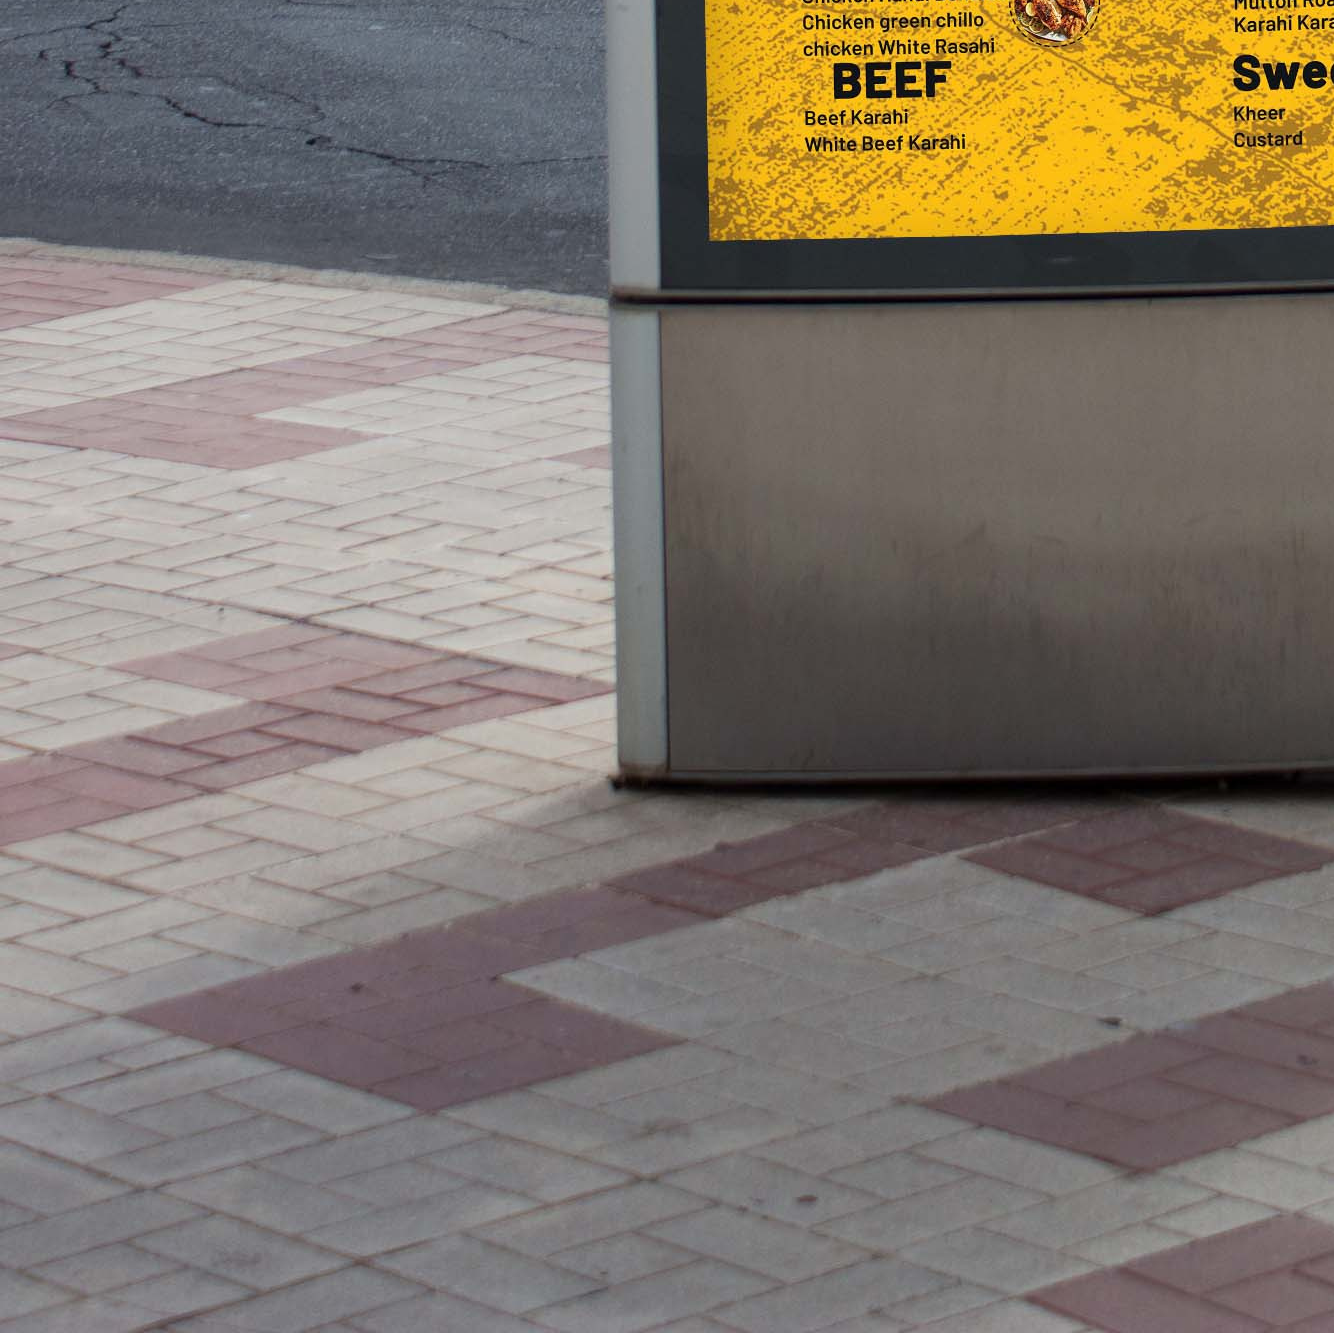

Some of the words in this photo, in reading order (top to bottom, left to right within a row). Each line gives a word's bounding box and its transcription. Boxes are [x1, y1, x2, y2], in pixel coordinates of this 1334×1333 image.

[803, 15, 874, 30] Chicken
[880, 17, 930, 32] green
[936, 12, 983, 27] chillo
[834, 61, 951, 99] BEEF
[1234, 106, 1285, 121] Kheer
[805, 137, 856, 151] White
[863, 136, 903, 151] Beef
[909, 134, 965, 150] Karahi
[1234, 131, 1302, 147] Custard
